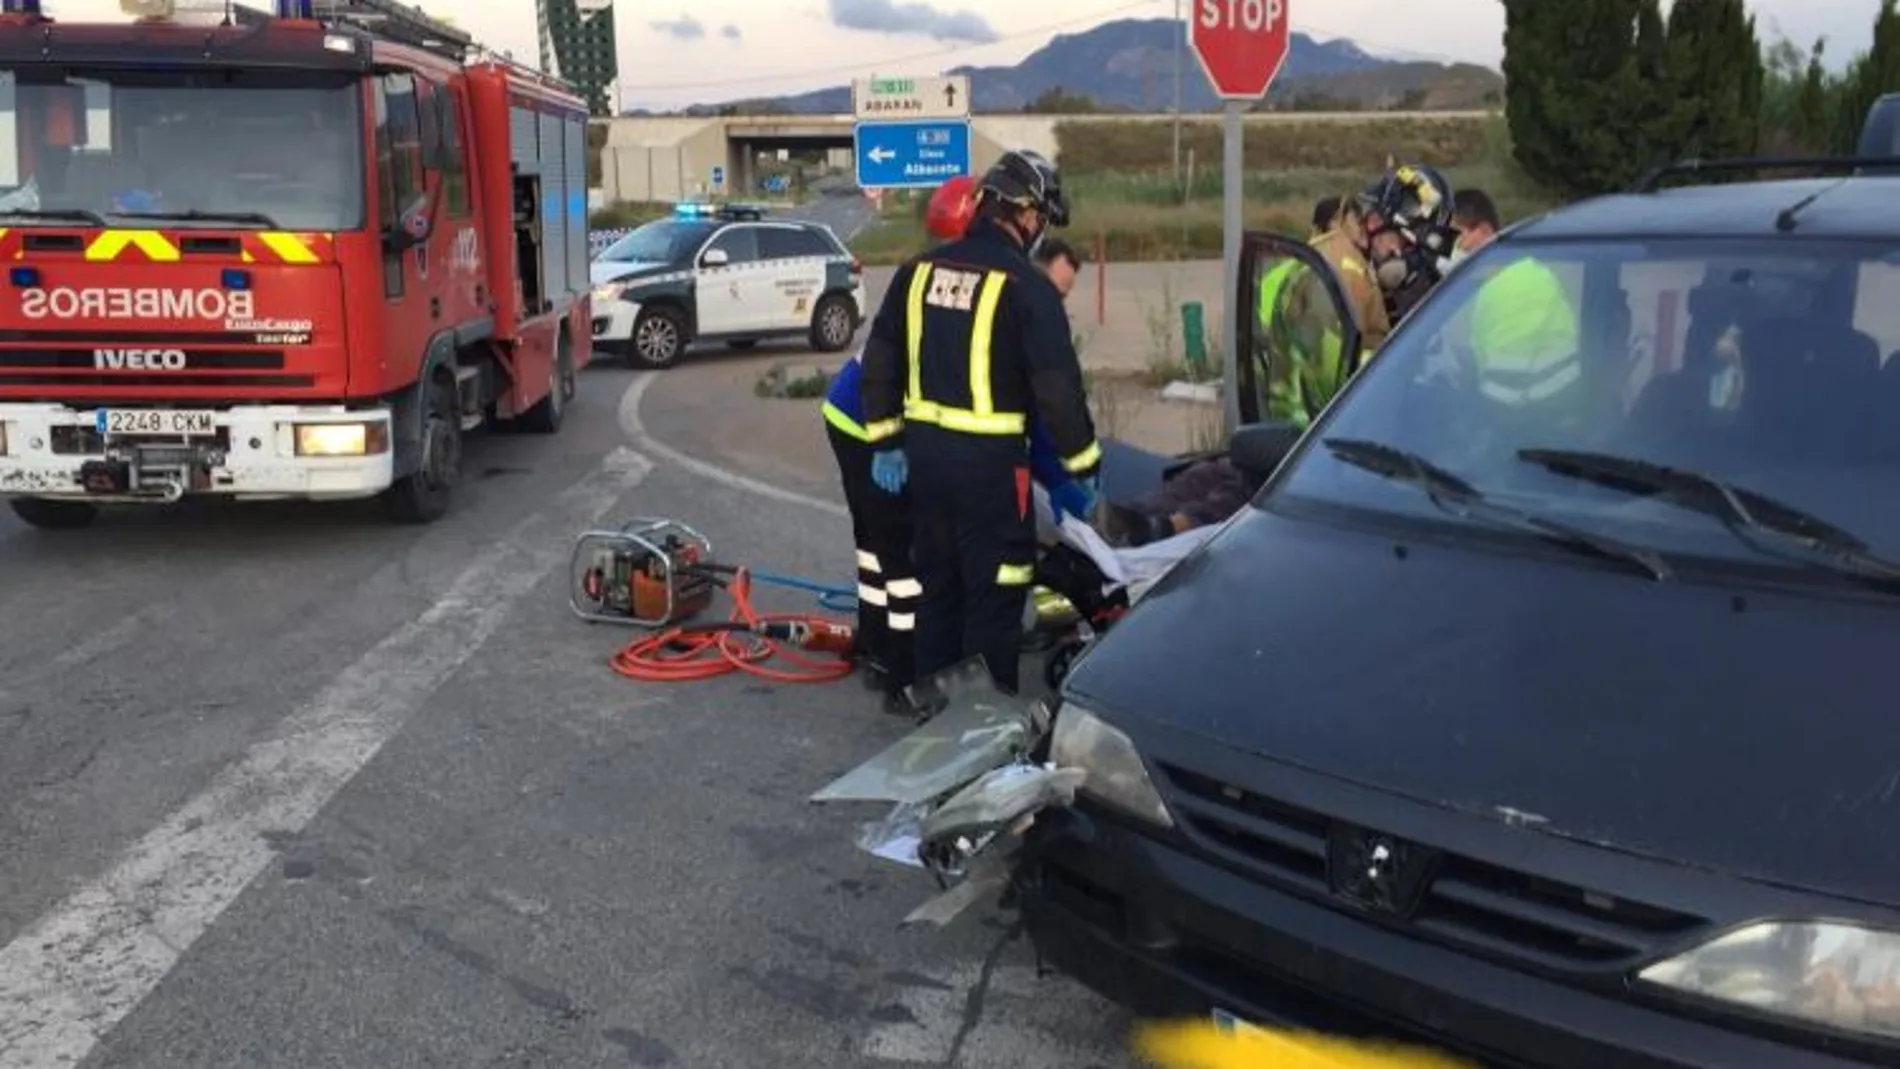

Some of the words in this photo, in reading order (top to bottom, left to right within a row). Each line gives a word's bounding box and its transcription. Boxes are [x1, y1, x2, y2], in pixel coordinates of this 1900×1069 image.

[1200, 0, 1282, 32] STOP
[904, 162, 962, 176] Albacete
[93, 349, 187, 370] IVECO
[111, 412, 161, 431] 2248
[171, 412, 212, 431] CKM
